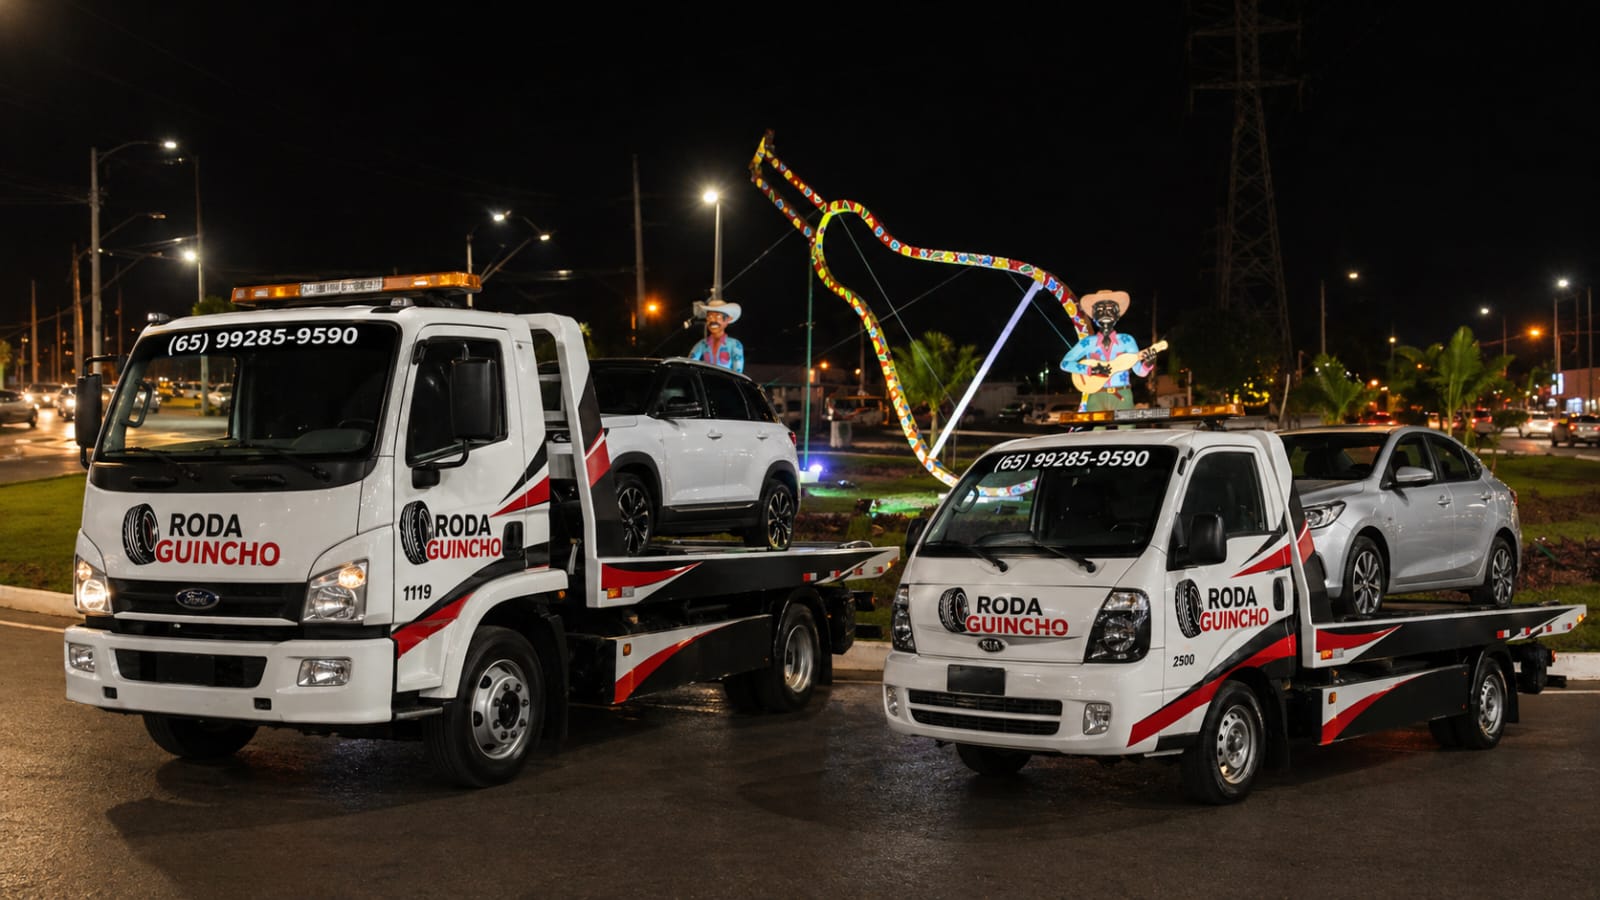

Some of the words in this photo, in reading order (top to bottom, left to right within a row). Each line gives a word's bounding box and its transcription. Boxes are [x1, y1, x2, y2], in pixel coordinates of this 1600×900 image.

[168, 333, 209, 356] (65)
[215, 327, 358, 348] 99285-9590
[994, 453, 1031, 473] (65)
[1032, 450, 1149, 467] 99285-9590
[169, 513, 242, 538] RODA
[435, 514, 491, 537] RODA
[155, 539, 280, 566] GUINCHO
[426, 538, 502, 560] GUINCHO
[403, 584, 432, 601] 1119
[1208, 586, 1258, 609] RODA
[977, 596, 1043, 616] RODA
[966, 615, 1069, 636] GUINCHO
[1200, 607, 1269, 632] GUINCHO
[982, 640, 1000, 651] KIA
[1173, 654, 1195, 667] 2500
